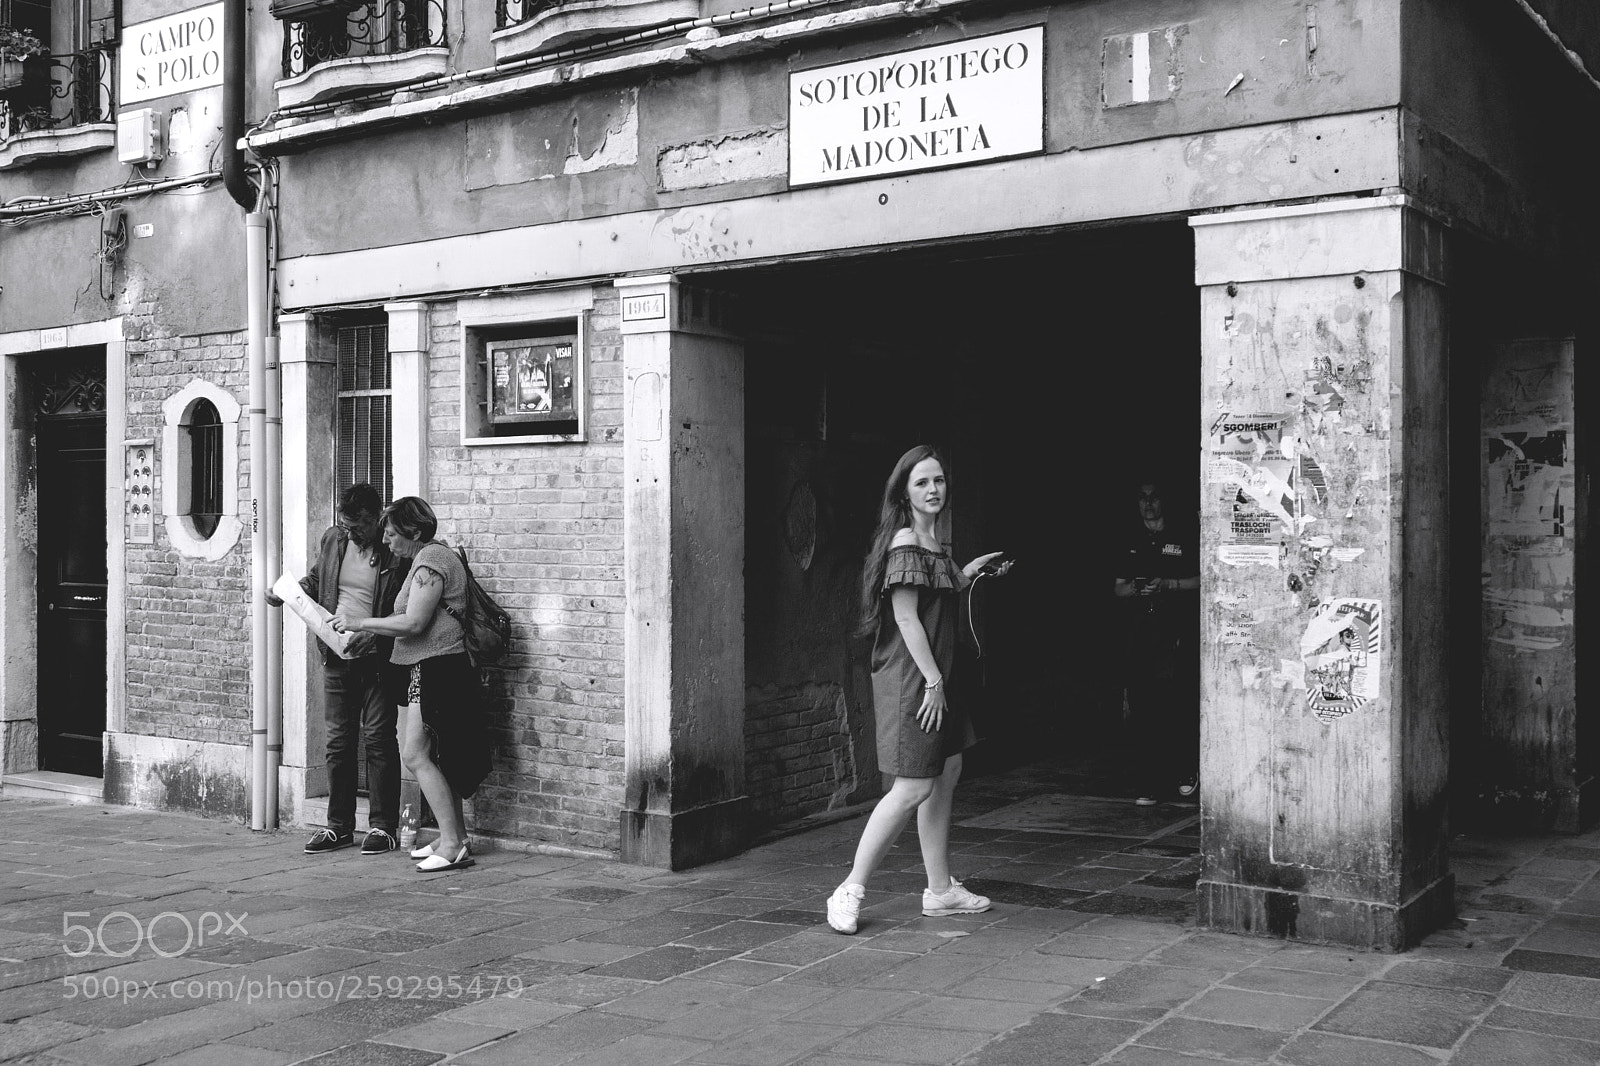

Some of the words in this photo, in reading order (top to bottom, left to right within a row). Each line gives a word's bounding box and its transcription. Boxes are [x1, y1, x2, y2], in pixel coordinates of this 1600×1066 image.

[140, 16, 214, 56] CAMPO
[136, 66, 150, 90] S.
[158, 50, 219, 87] POLO
[800, 42, 1028, 106] SOTOPORTEGO
[863, 101, 901, 132] DE
[919, 92, 958, 123] LA
[821, 123, 991, 173] MADONETA
[628, 299, 660, 315] 1964
